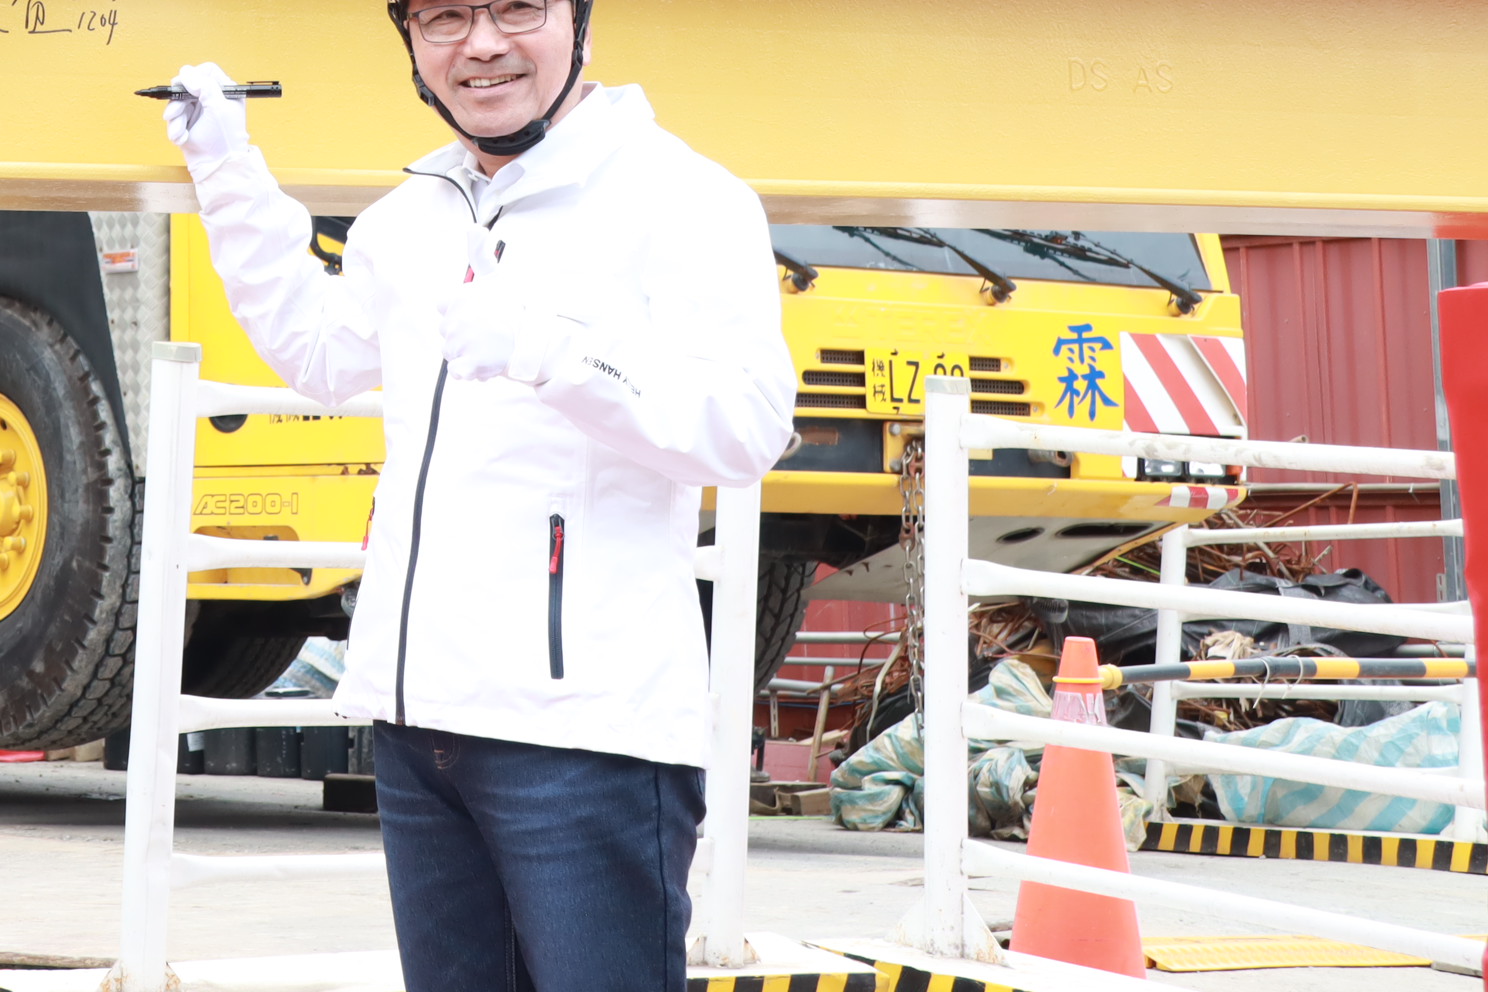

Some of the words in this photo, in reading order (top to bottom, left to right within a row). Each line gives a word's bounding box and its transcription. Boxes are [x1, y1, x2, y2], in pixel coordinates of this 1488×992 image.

[78, 9, 119, 45] 1204
[1068, 56, 1110, 94] DS
[1132, 59, 1175, 95] AS
[1052, 323, 1120, 422] 霖
